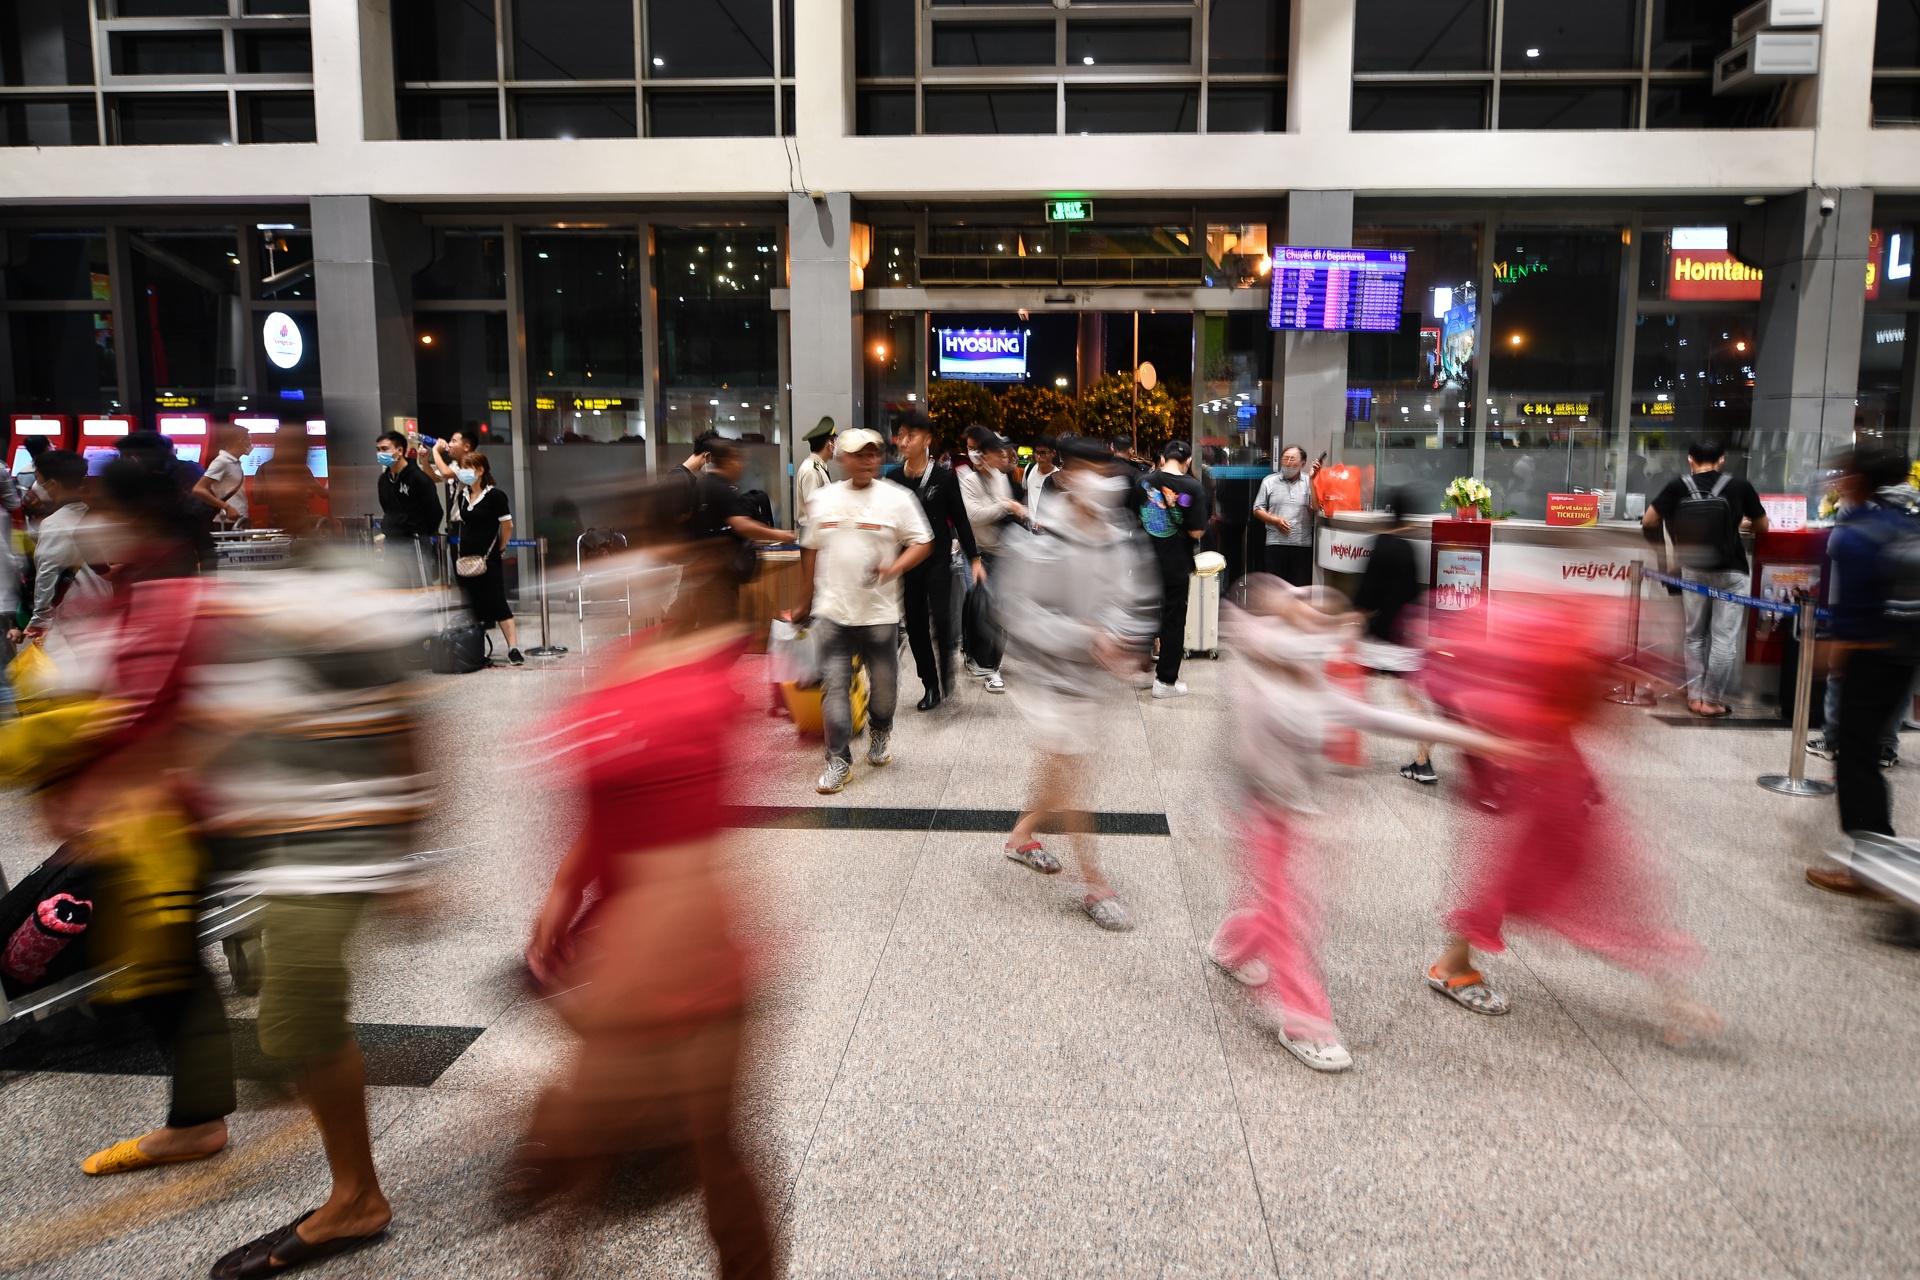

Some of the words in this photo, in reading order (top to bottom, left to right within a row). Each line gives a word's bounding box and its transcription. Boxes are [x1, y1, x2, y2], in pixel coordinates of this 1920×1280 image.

[1326, 250, 1365, 262] Departures
[945, 336, 1020, 353] HYOSUNG
[1557, 511, 1591, 519] TICKETING
